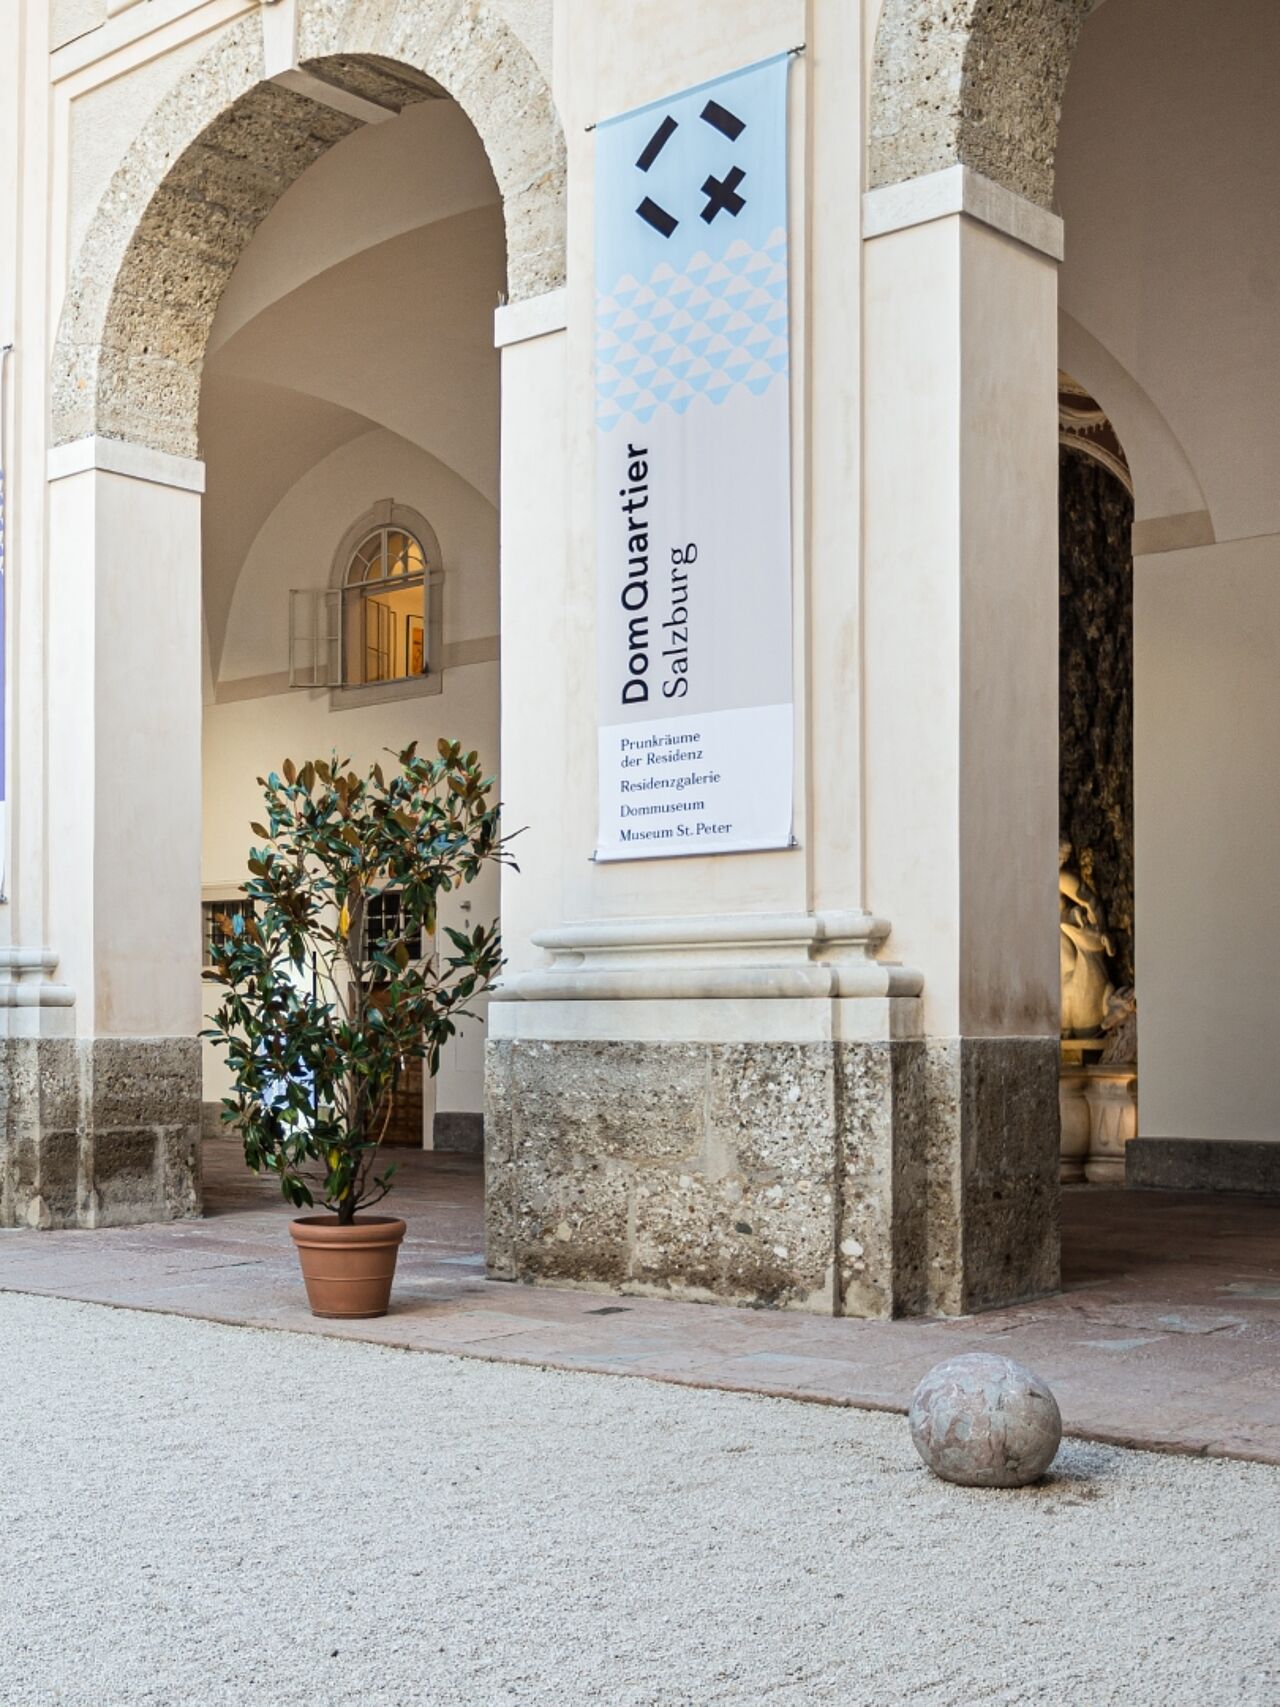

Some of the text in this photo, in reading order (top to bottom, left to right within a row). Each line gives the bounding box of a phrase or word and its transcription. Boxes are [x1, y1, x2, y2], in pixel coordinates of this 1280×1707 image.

[662, 543, 698, 698] Salzburg
[620, 733, 701, 752] Prunkräume
[620, 749, 704, 768] der Residenz
[620, 771, 721, 793] Residenzgalerie
[620, 801, 705, 818] Dommuseum
[619, 822, 733, 842] Museum St. Peter
